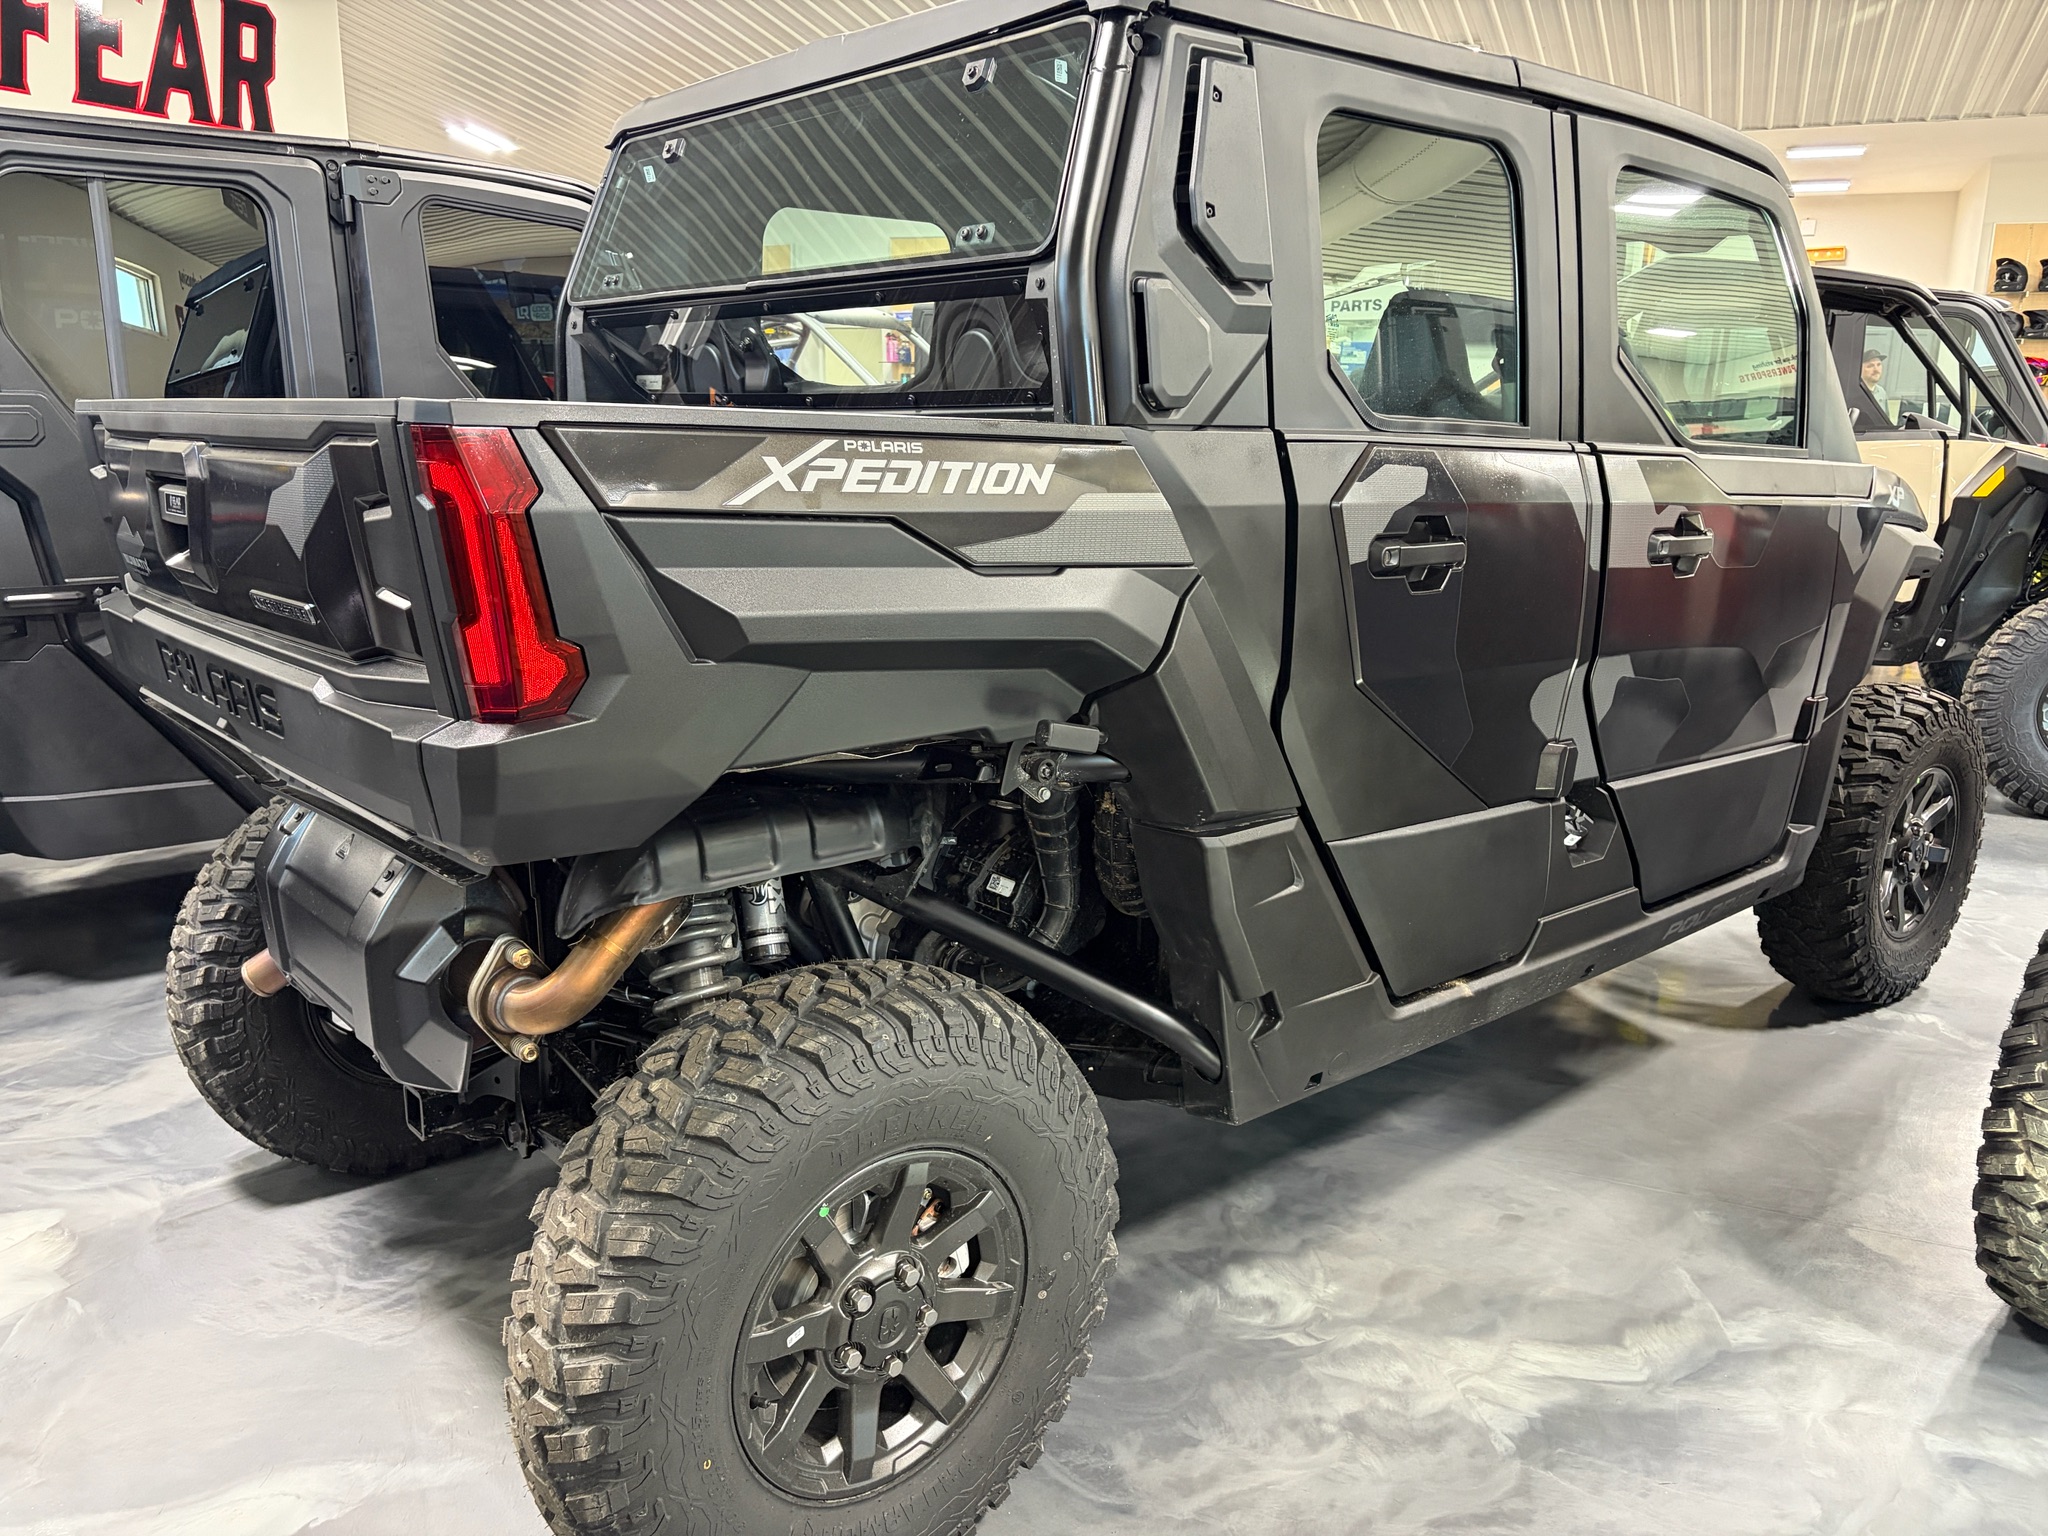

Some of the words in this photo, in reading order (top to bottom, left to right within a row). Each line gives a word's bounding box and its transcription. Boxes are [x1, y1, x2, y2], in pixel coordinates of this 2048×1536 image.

[1330, 299, 1382, 312] PARTS
[843, 439, 924, 454] POLARIS
[722, 439, 1057, 506] XPEDITION
[1886, 484, 1905, 508] XP
[156, 638, 285, 740] POLARIS
